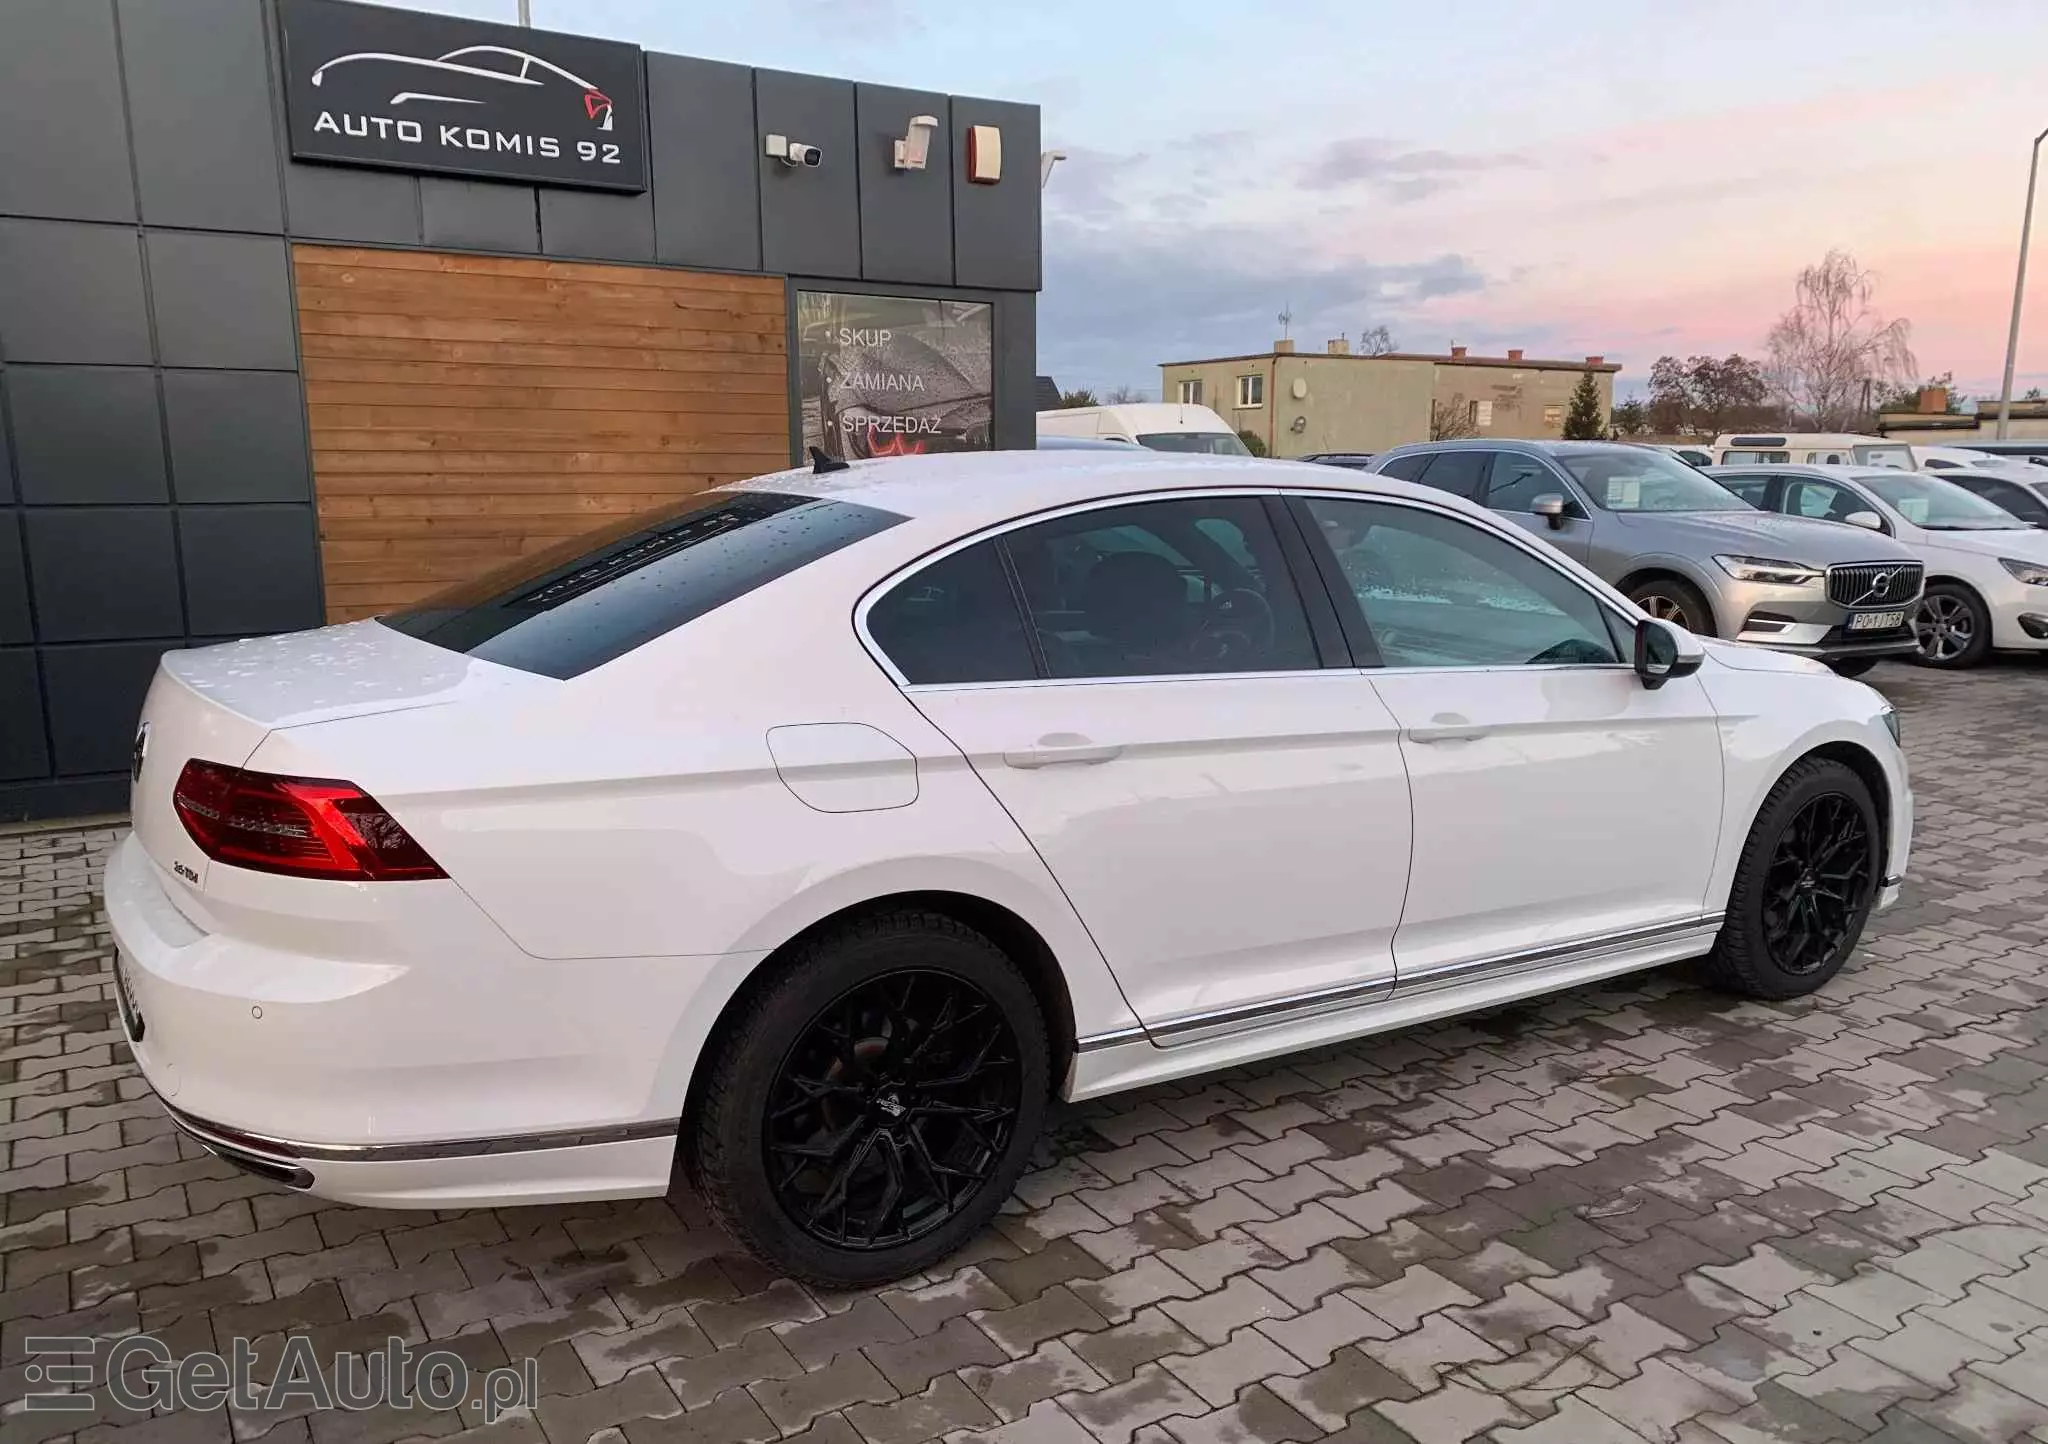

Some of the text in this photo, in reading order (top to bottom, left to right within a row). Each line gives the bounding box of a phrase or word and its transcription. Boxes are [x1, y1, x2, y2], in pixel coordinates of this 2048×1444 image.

[314, 111, 620, 164] AUTO KOMIS 92
[839, 328, 892, 347] SKUP
[841, 372, 925, 392] ZAMIANA
